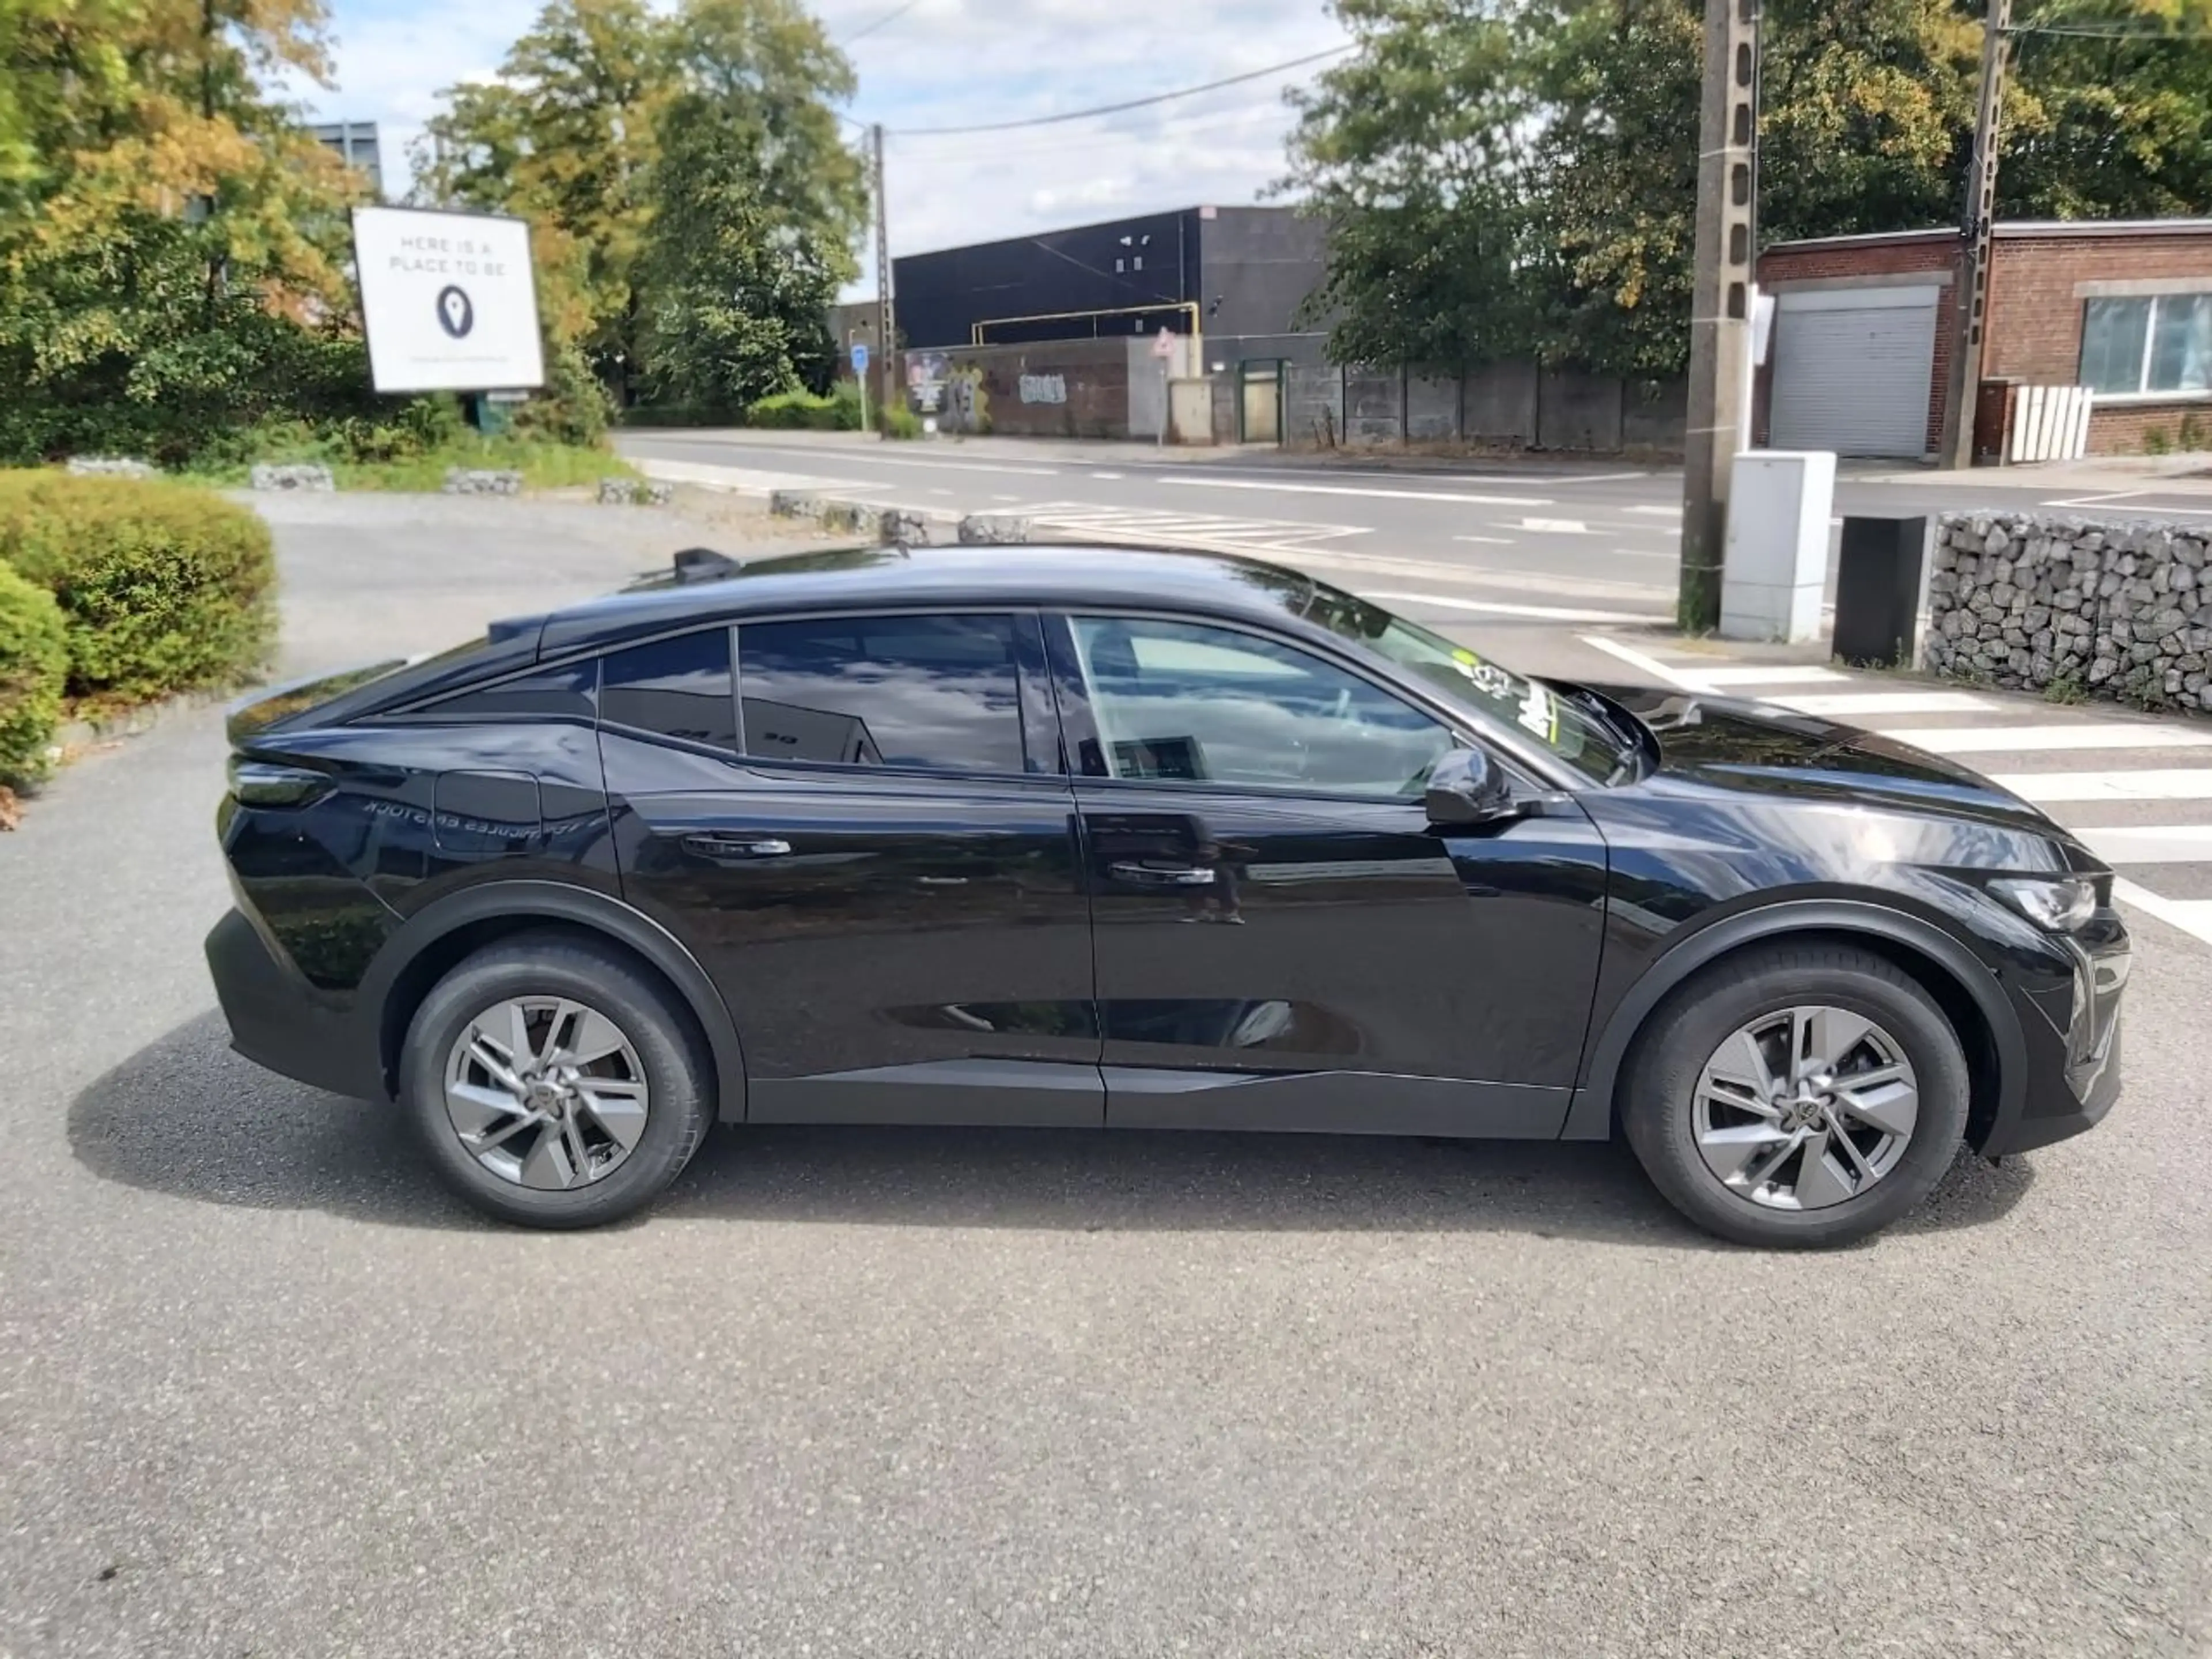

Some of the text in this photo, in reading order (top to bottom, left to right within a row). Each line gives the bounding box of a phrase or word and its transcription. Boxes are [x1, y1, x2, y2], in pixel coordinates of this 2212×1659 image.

[401, 236, 491, 255] HERE IS A
[389, 256, 510, 276] PLACE TO BE
